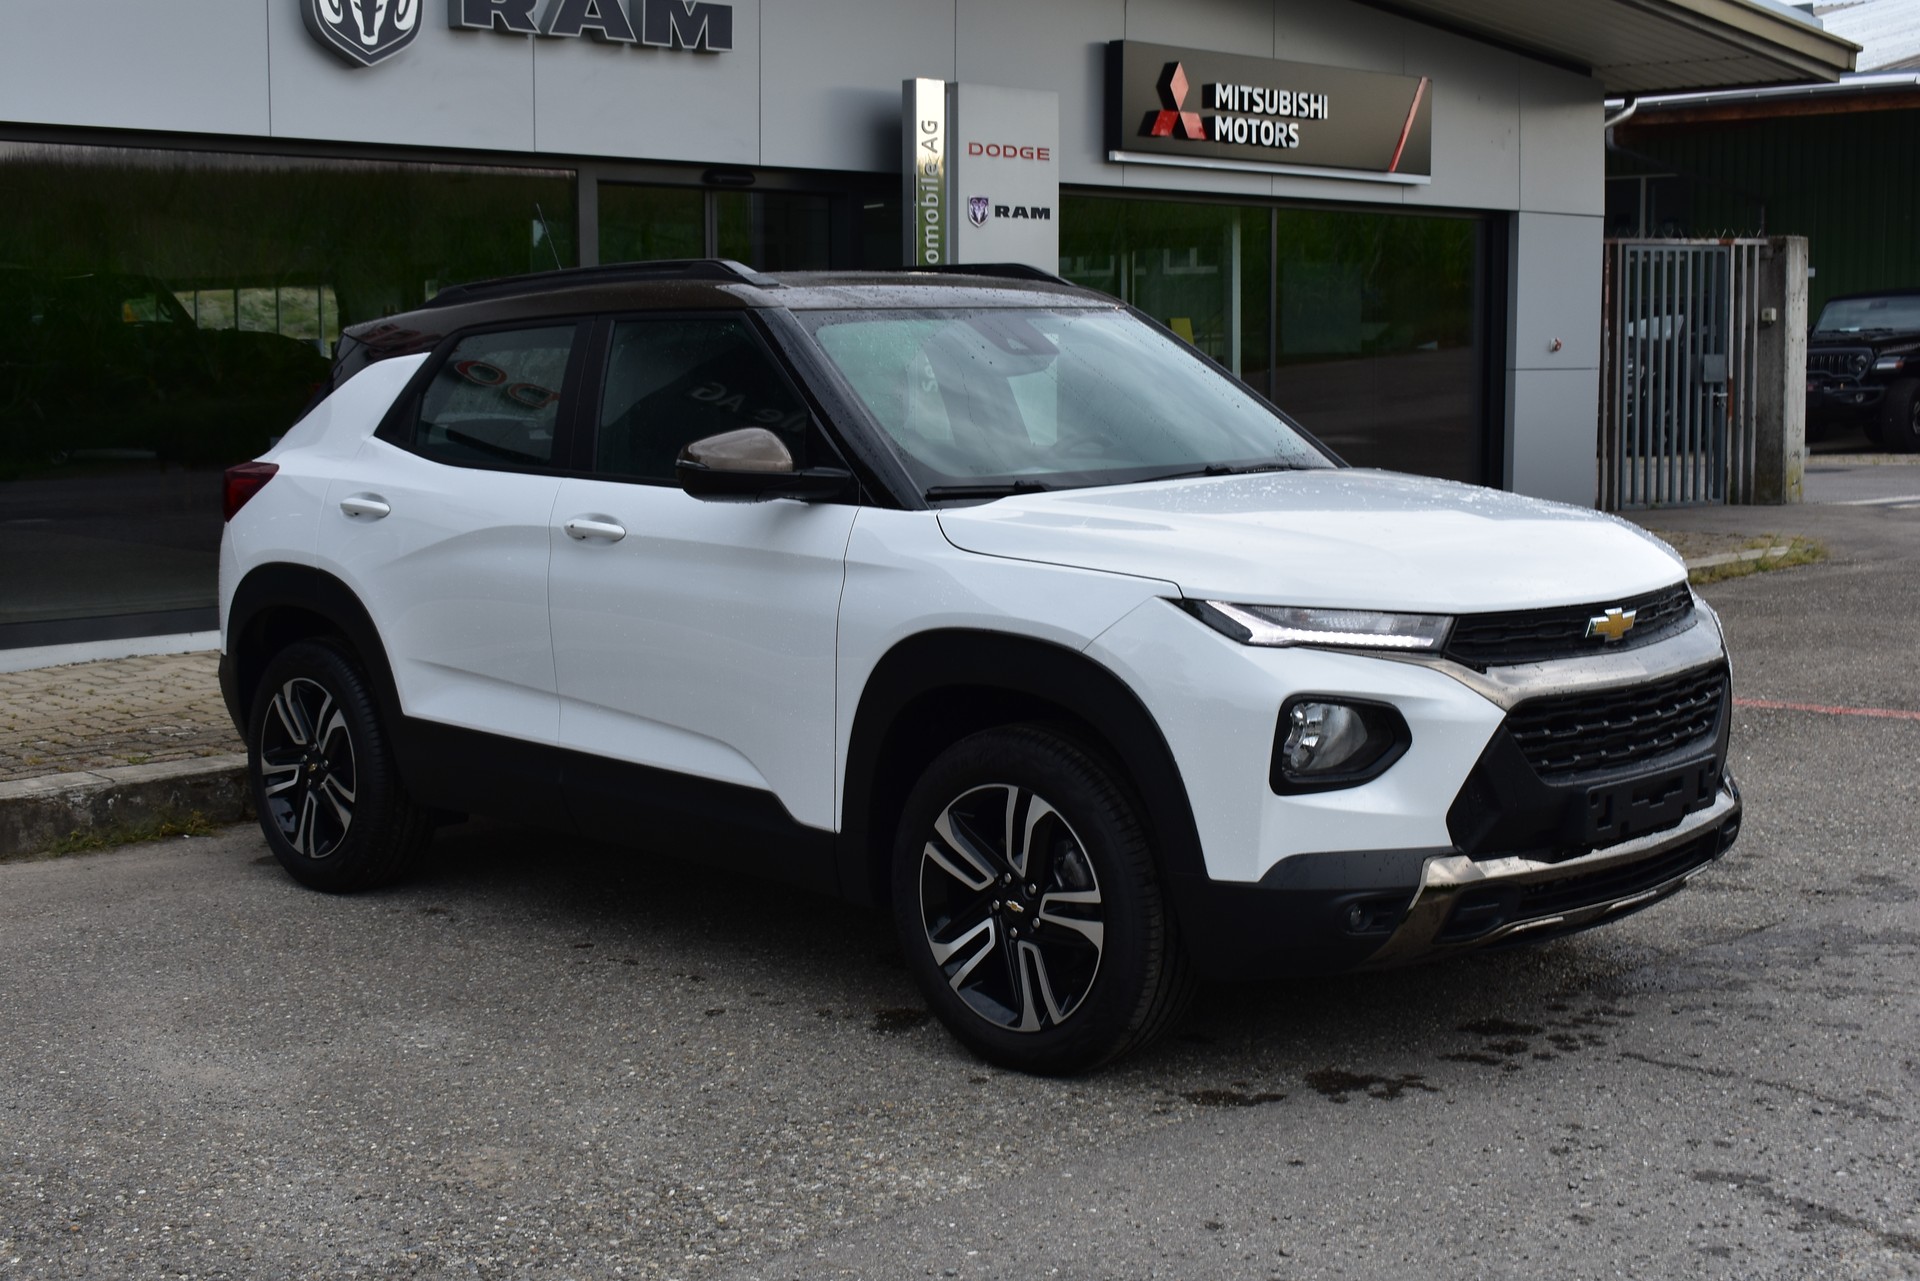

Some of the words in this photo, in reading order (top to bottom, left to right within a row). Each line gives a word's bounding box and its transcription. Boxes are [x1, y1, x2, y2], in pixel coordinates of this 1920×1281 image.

[1214, 82, 1329, 120] MITSUBISHI
[921, 120, 938, 153] AG
[1214, 115, 1300, 148] MOTORS
[968, 142, 1050, 161] DODGE
[995, 205, 1051, 220] RAM
